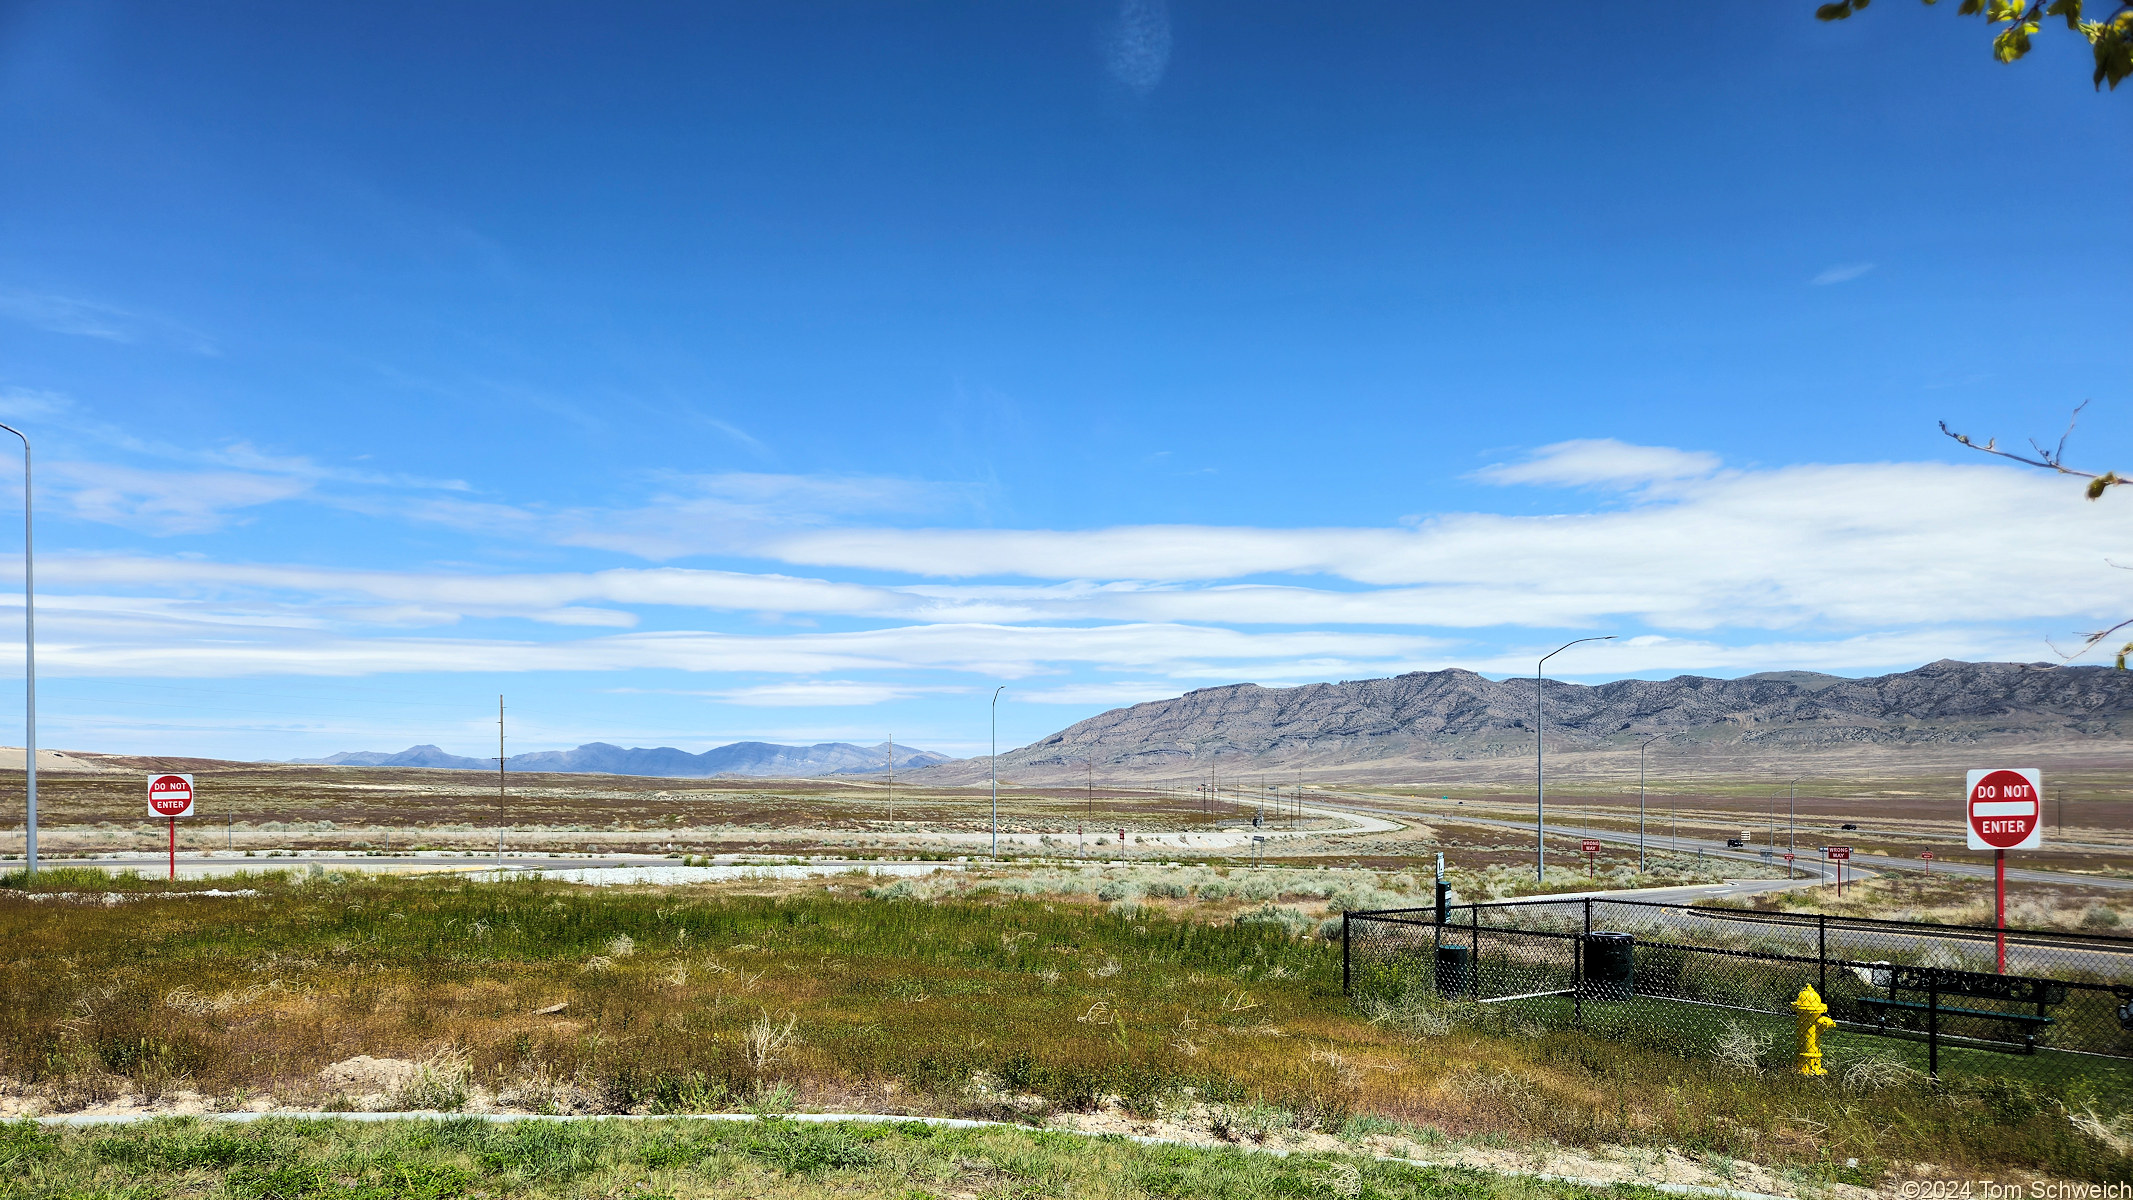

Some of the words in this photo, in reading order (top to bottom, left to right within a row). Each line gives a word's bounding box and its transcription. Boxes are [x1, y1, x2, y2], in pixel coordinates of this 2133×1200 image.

[1977, 785, 1996, 799] DO
[2003, 785, 2029, 798] NOT
[157, 801, 184, 809] ENTER
[1982, 820, 2025, 834] ENTER
